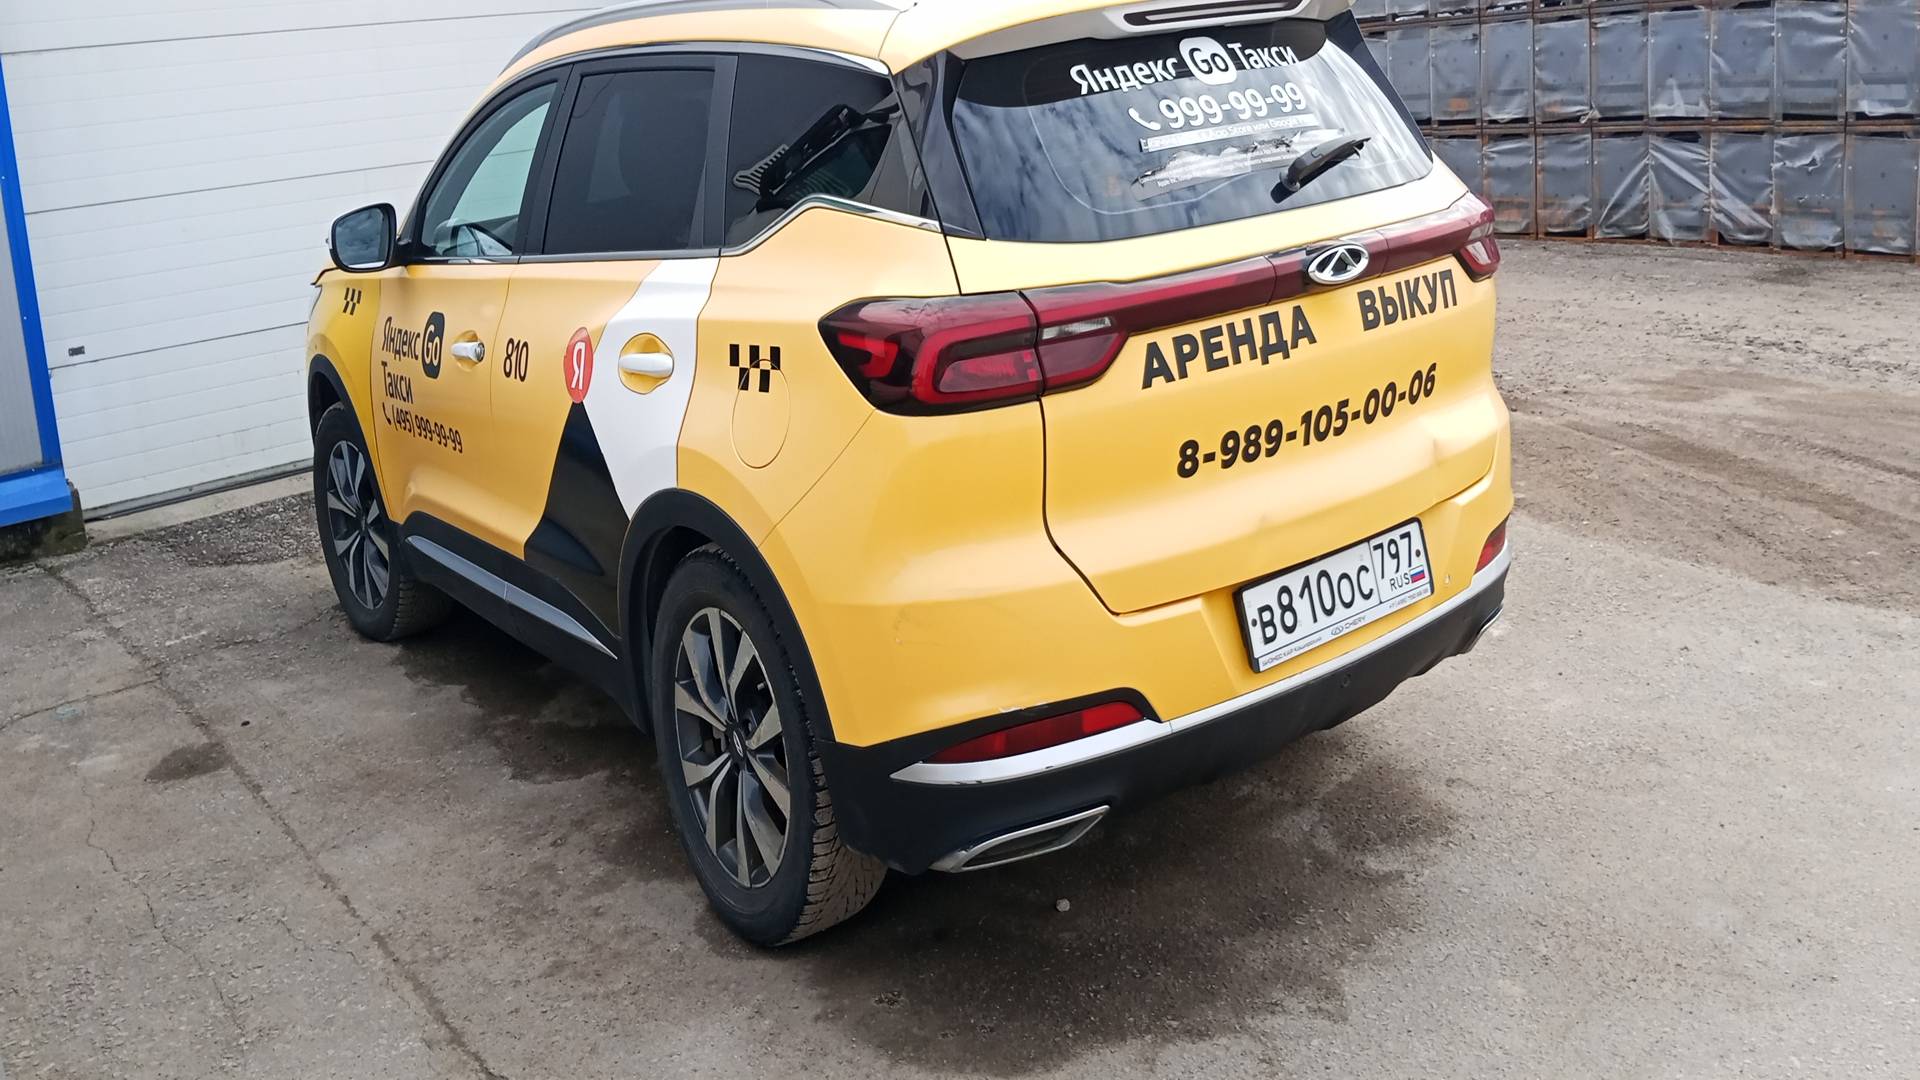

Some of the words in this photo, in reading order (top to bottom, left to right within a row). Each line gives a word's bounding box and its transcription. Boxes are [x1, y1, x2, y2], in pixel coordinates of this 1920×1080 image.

[1070, 57, 1178, 95] Яндекс
[1190, 46, 1229, 75] Go
[1227, 42, 1299, 71] Такси
[1158, 82, 1307, 129] 999-99-99
[382, 316, 421, 361] Яндекс
[424, 324, 441, 366] Go
[1141, 305, 1317, 389] АРЕНДА
[1357, 269, 1458, 331] ВЫКУП
[381, 361, 413, 404] Такси
[503, 337, 529, 382] 810
[571, 341, 586, 391] Я
[392, 404, 416, 438] (495)
[415, 414, 463, 454] 999-99-99
[1177, 363, 1437, 479] 8-989-105-00-06
[1372, 531, 1413, 579] 797
[1390, 572, 1410, 591] RUS
